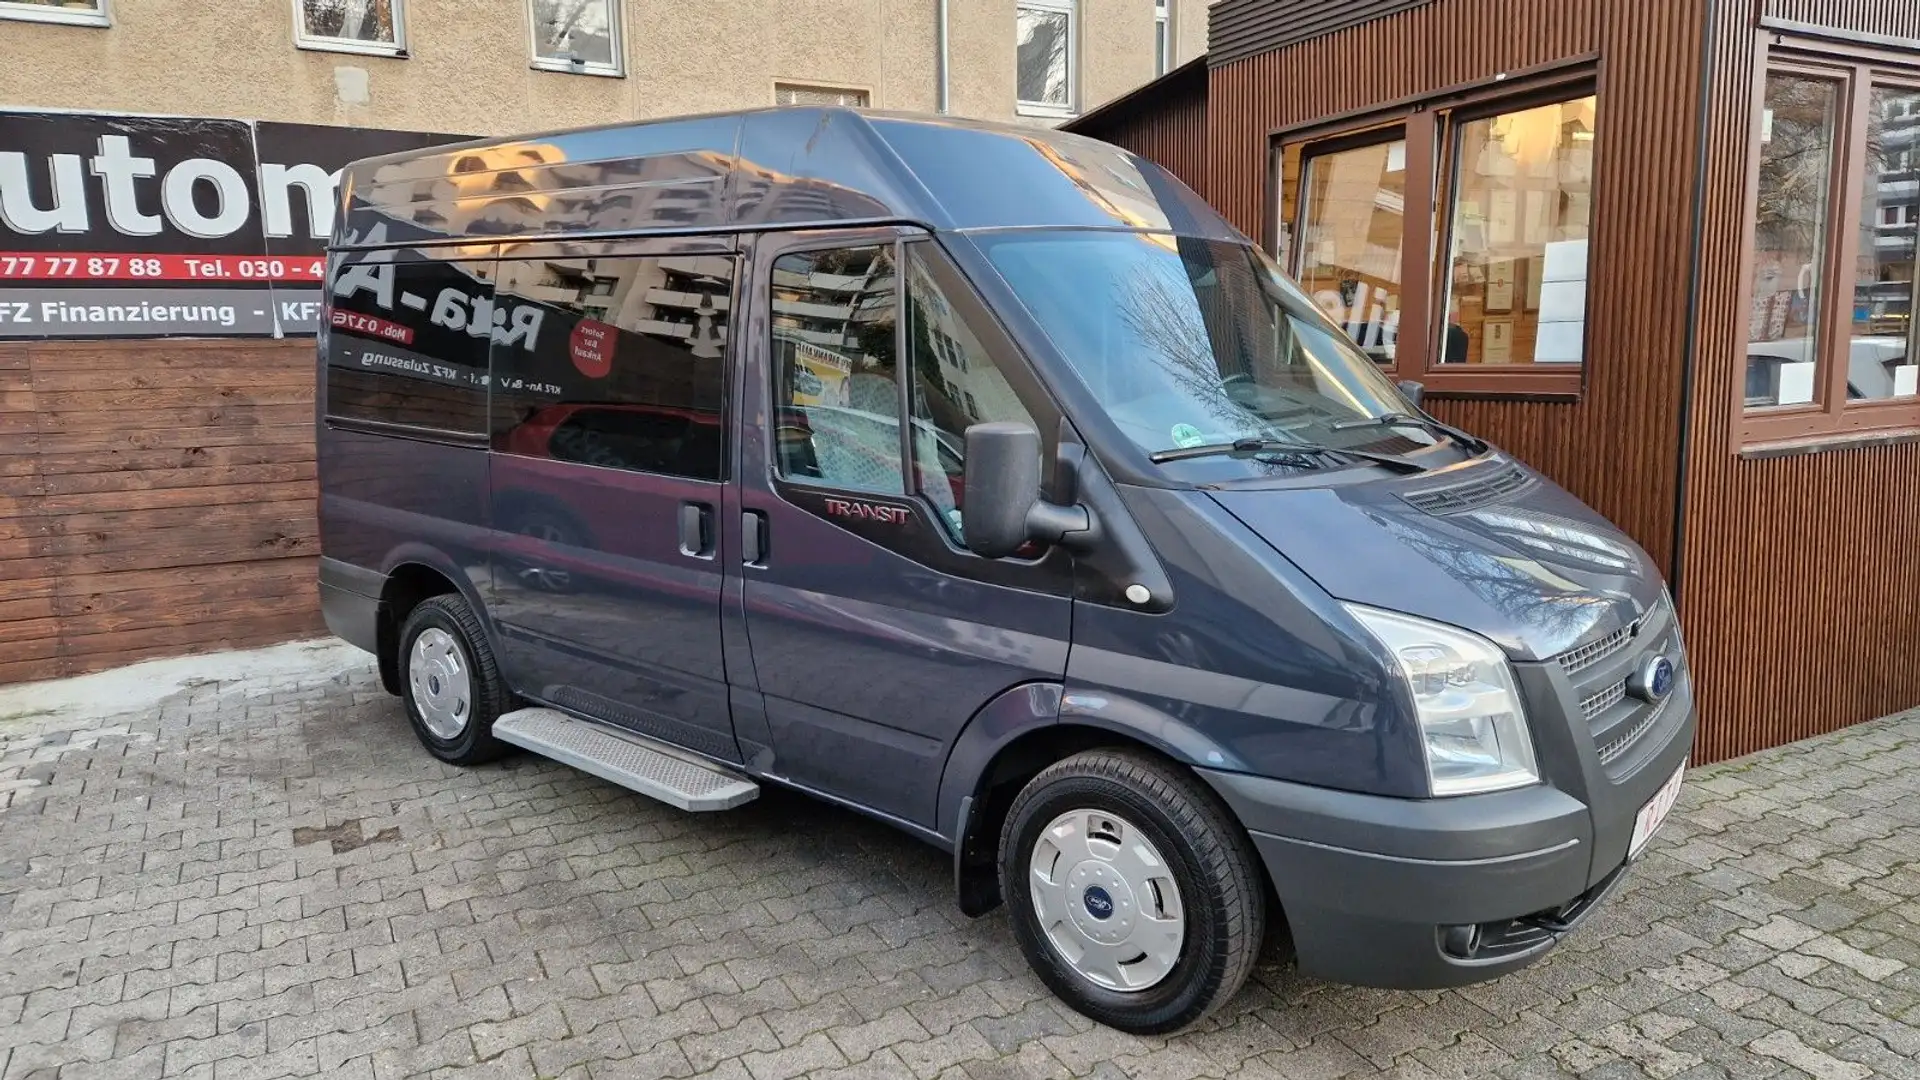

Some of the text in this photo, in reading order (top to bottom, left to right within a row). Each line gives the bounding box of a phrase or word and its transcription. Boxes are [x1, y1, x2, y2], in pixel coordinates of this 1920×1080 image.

[1, 257, 35, 276] 77
[45, 257, 78, 276] 77
[87, 258, 120, 276] 87
[129, 258, 162, 276] 88
[184, 259, 231, 277] Tel.
[239, 260, 284, 277] 030
[41, 301, 235, 326] Finanzierung
[824, 498, 910, 524] TRANSIT
